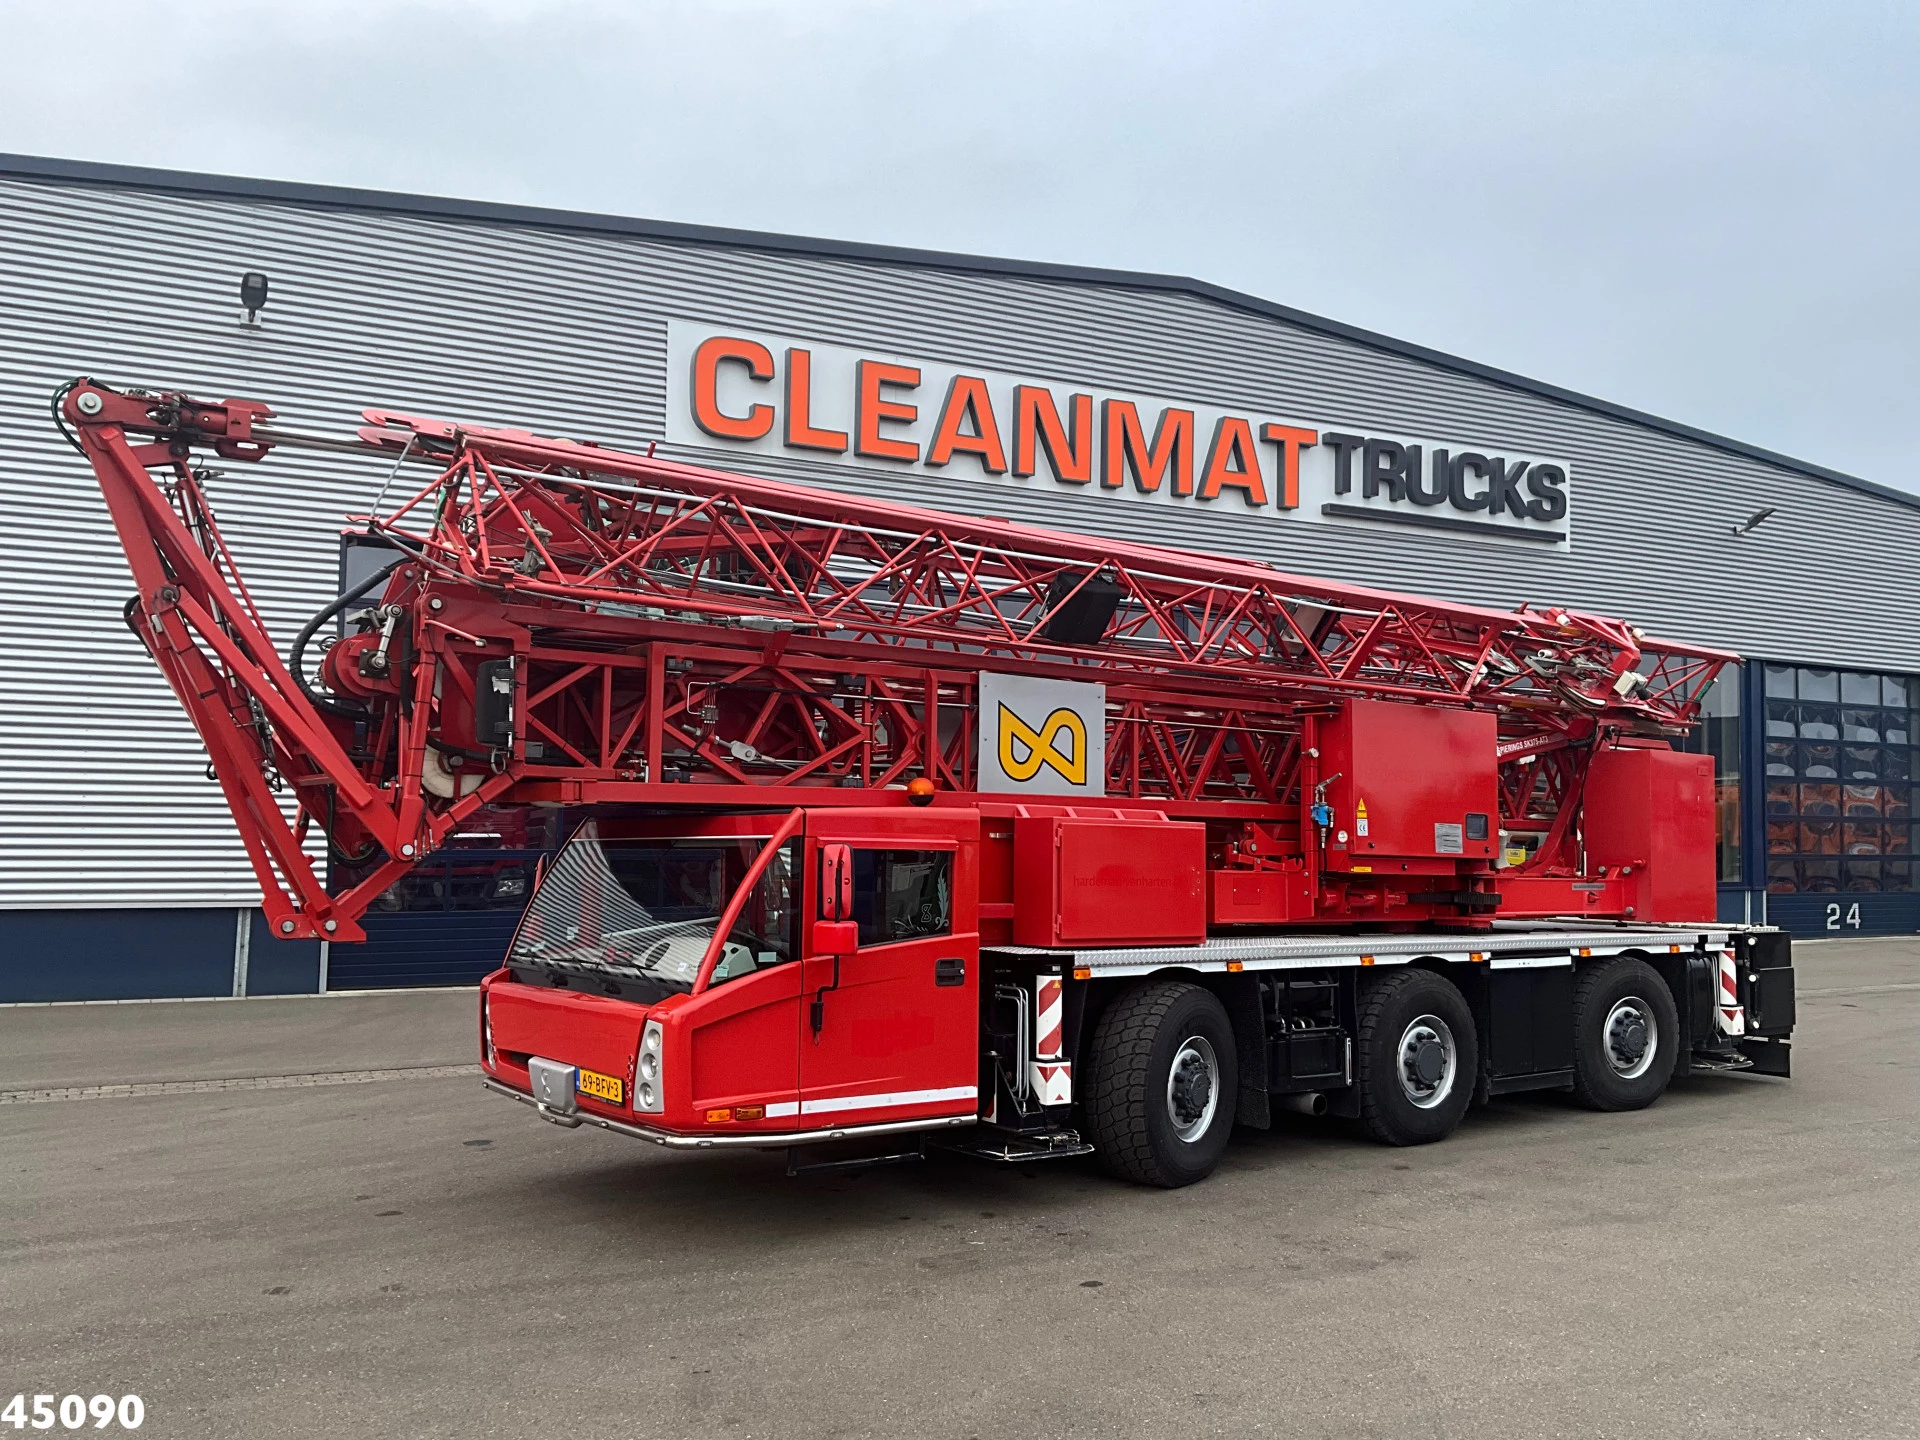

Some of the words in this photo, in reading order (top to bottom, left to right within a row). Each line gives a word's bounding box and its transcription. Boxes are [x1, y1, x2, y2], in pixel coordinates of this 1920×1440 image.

[690, 336, 1316, 510] CLEANMAT
[1322, 432, 1566, 521] TRUCKS
[1826, 903, 1861, 930] 24
[582, 1074, 619, 1098] 69-BFV-3
